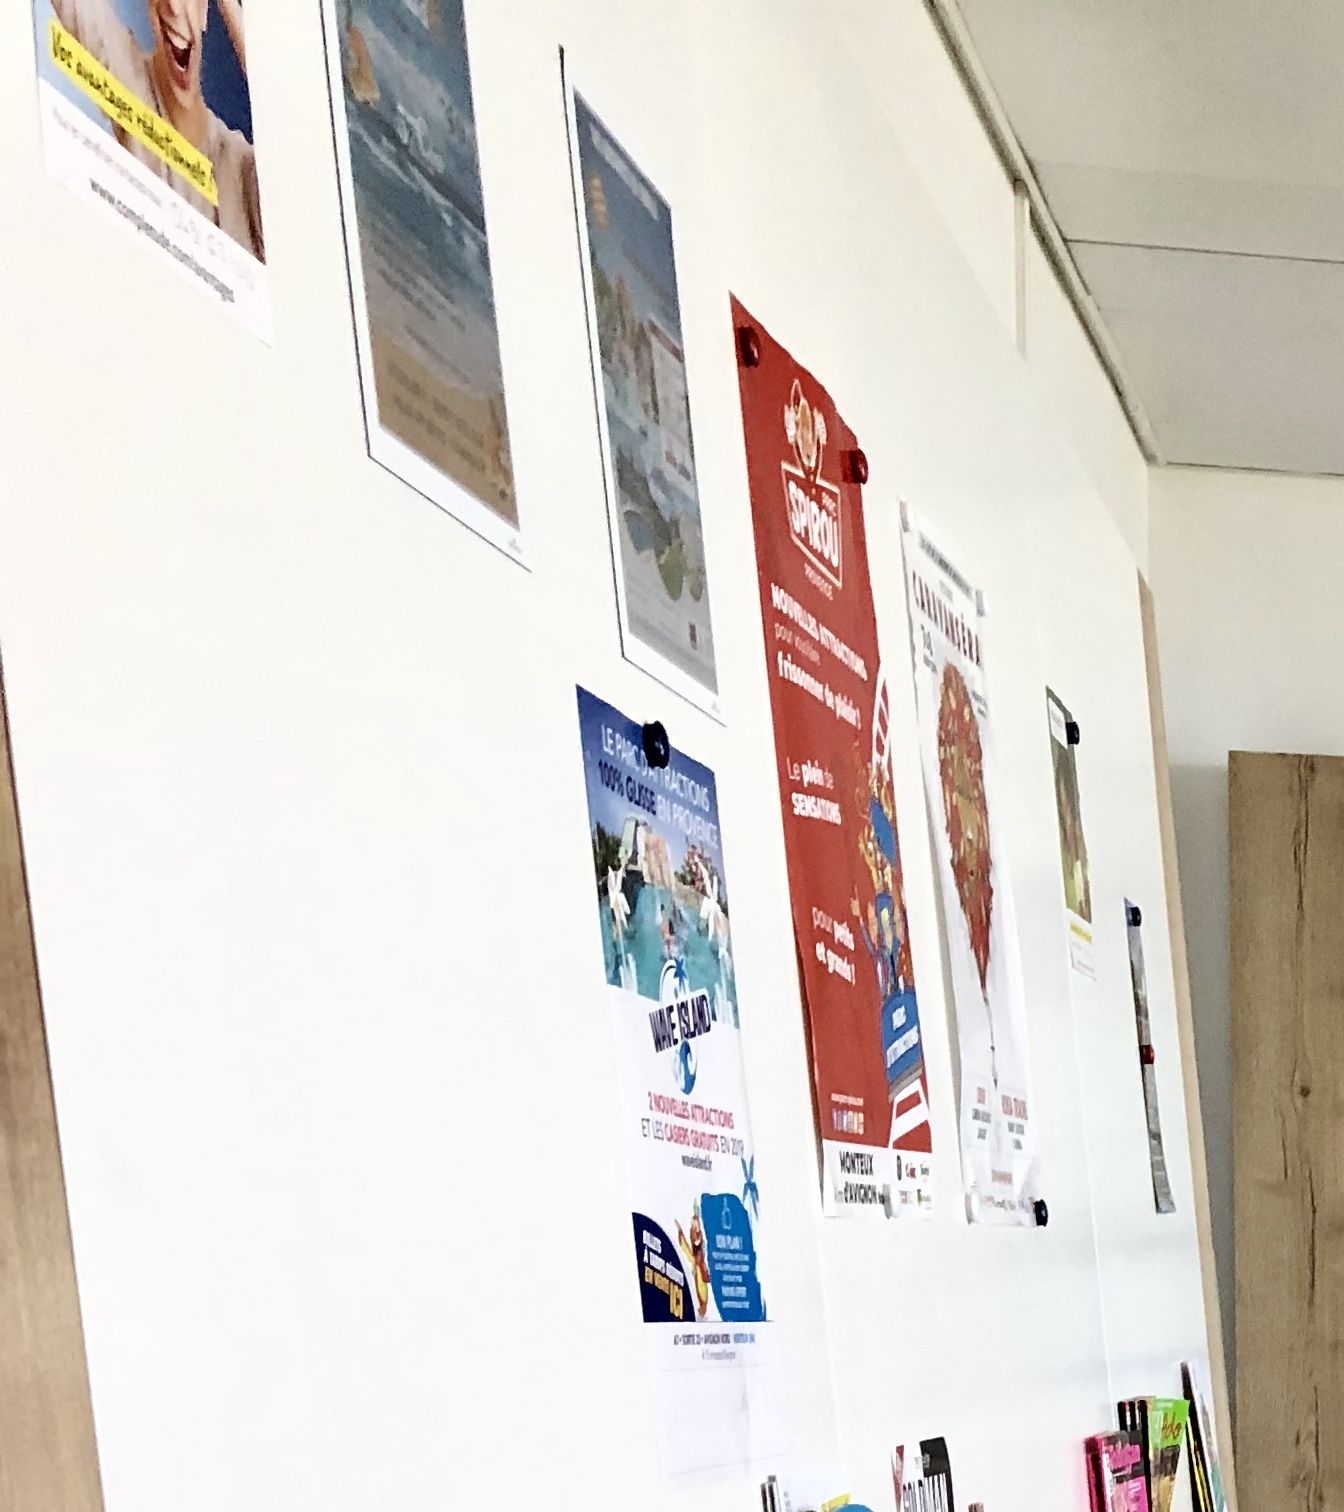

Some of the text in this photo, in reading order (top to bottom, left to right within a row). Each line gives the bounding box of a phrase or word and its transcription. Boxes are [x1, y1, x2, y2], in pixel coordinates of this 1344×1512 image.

[788, 480, 839, 568] SPIROU
[601, 724, 615, 756] LE
[786, 757, 801, 780] Le
[801, 758, 825, 787] plein
[812, 906, 833, 934] pour
[815, 941, 826, 965] et
[649, 994, 711, 1053] WAVE ISLAND
[690, 1103, 734, 1130] ATTRACTIONS
[641, 1117, 651, 1138] ET
[652, 1118, 664, 1141] LES
[720, 1135, 730, 1154] EN
[839, 1150, 874, 1177] MONTEUX
